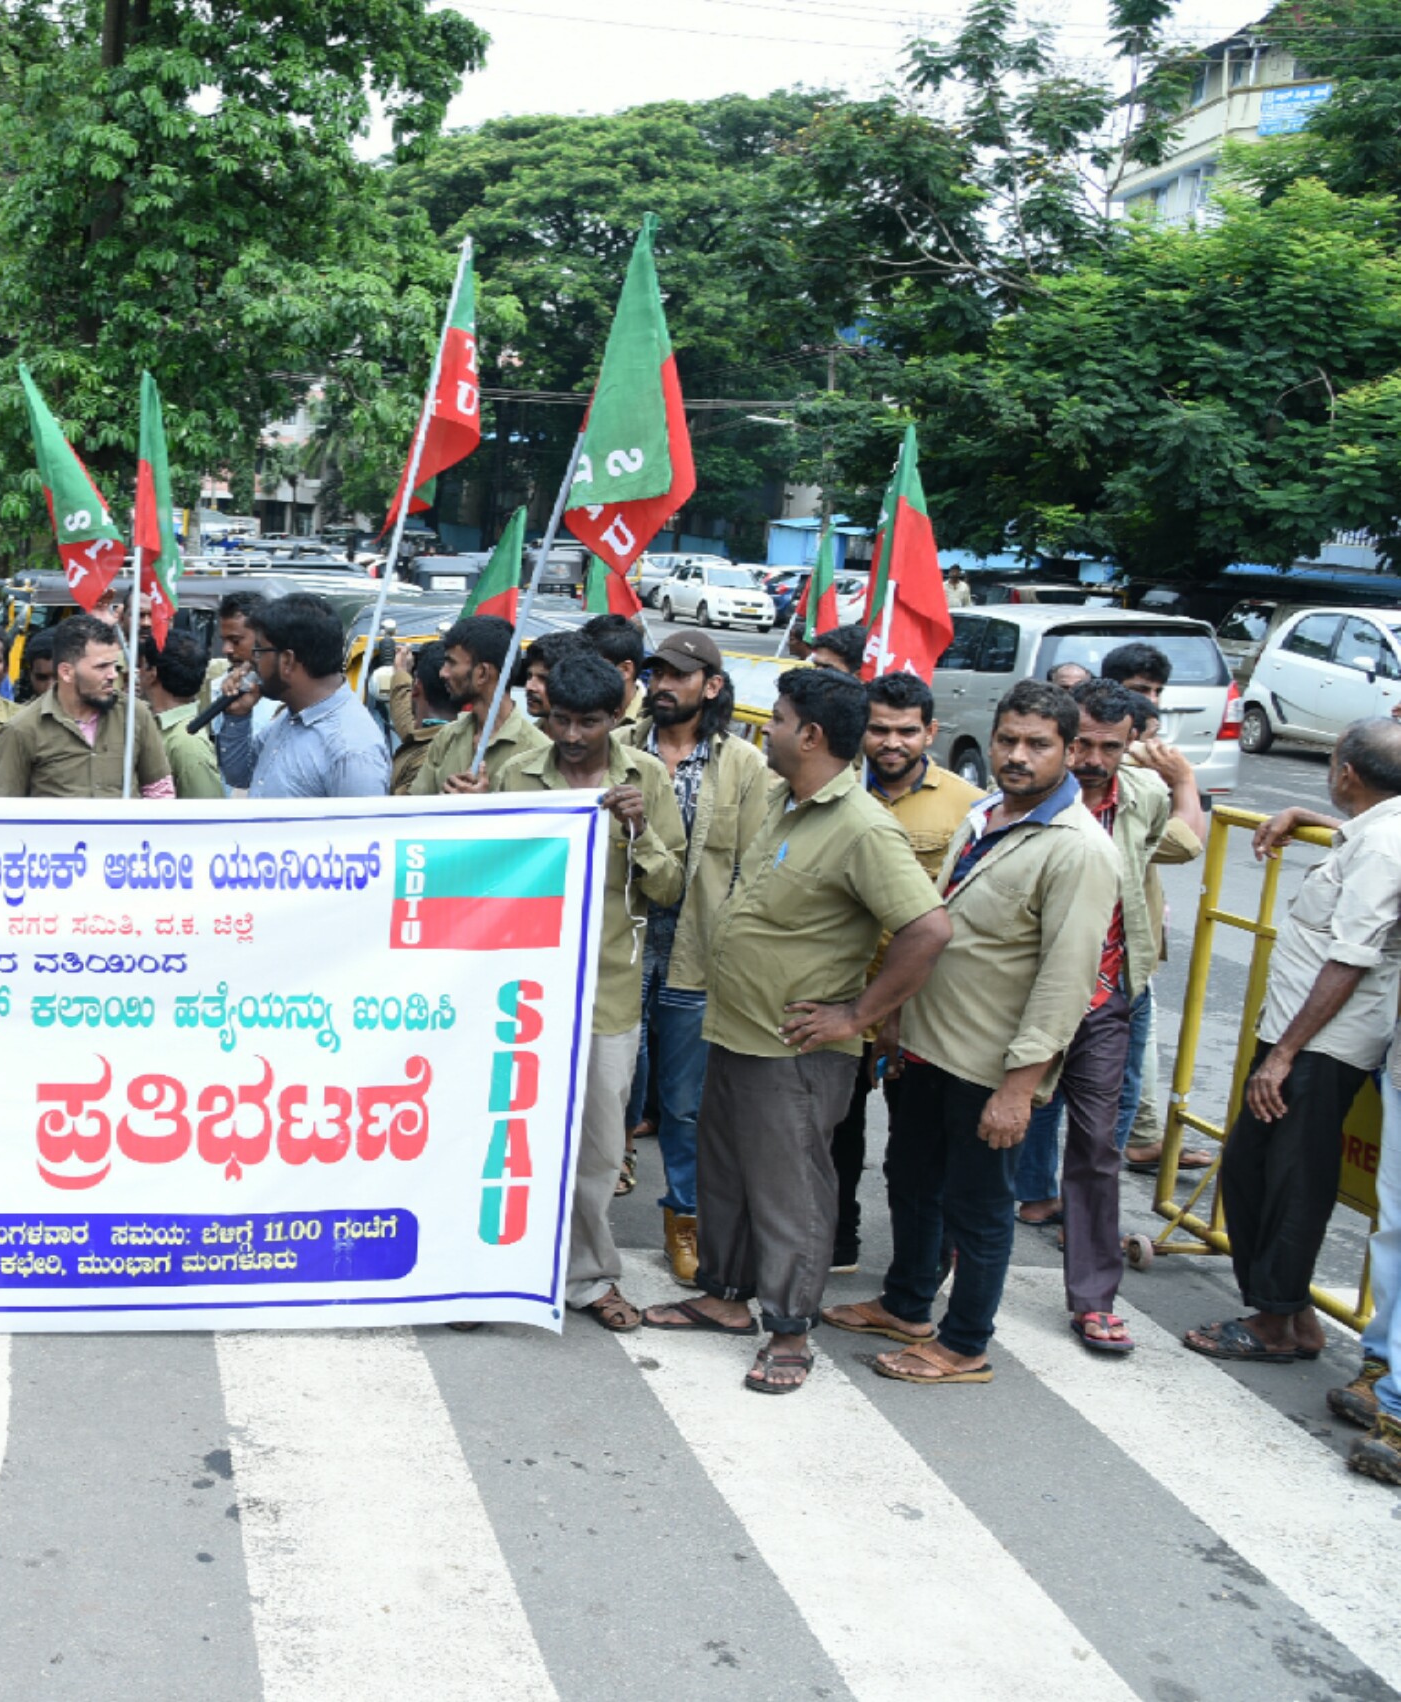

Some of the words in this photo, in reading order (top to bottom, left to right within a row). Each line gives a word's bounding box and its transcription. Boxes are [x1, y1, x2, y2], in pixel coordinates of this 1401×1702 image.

[104, 840, 193, 889] ಆಟೋ
[210, 841, 381, 891] ಯೂನಿಯನ್
[401, 844, 425, 945] SDTU
[10, 918, 56, 934] ನಗರ
[34, 952, 188, 973] ವತಿಯಿಂದ
[31, 994, 155, 1028] ಕಲಾಯಿ
[478, 980, 544, 1245] SDAU
[111, 1223, 190, 1245] ಸಮಯ:
[264, 1220, 321, 1241] 11.00
